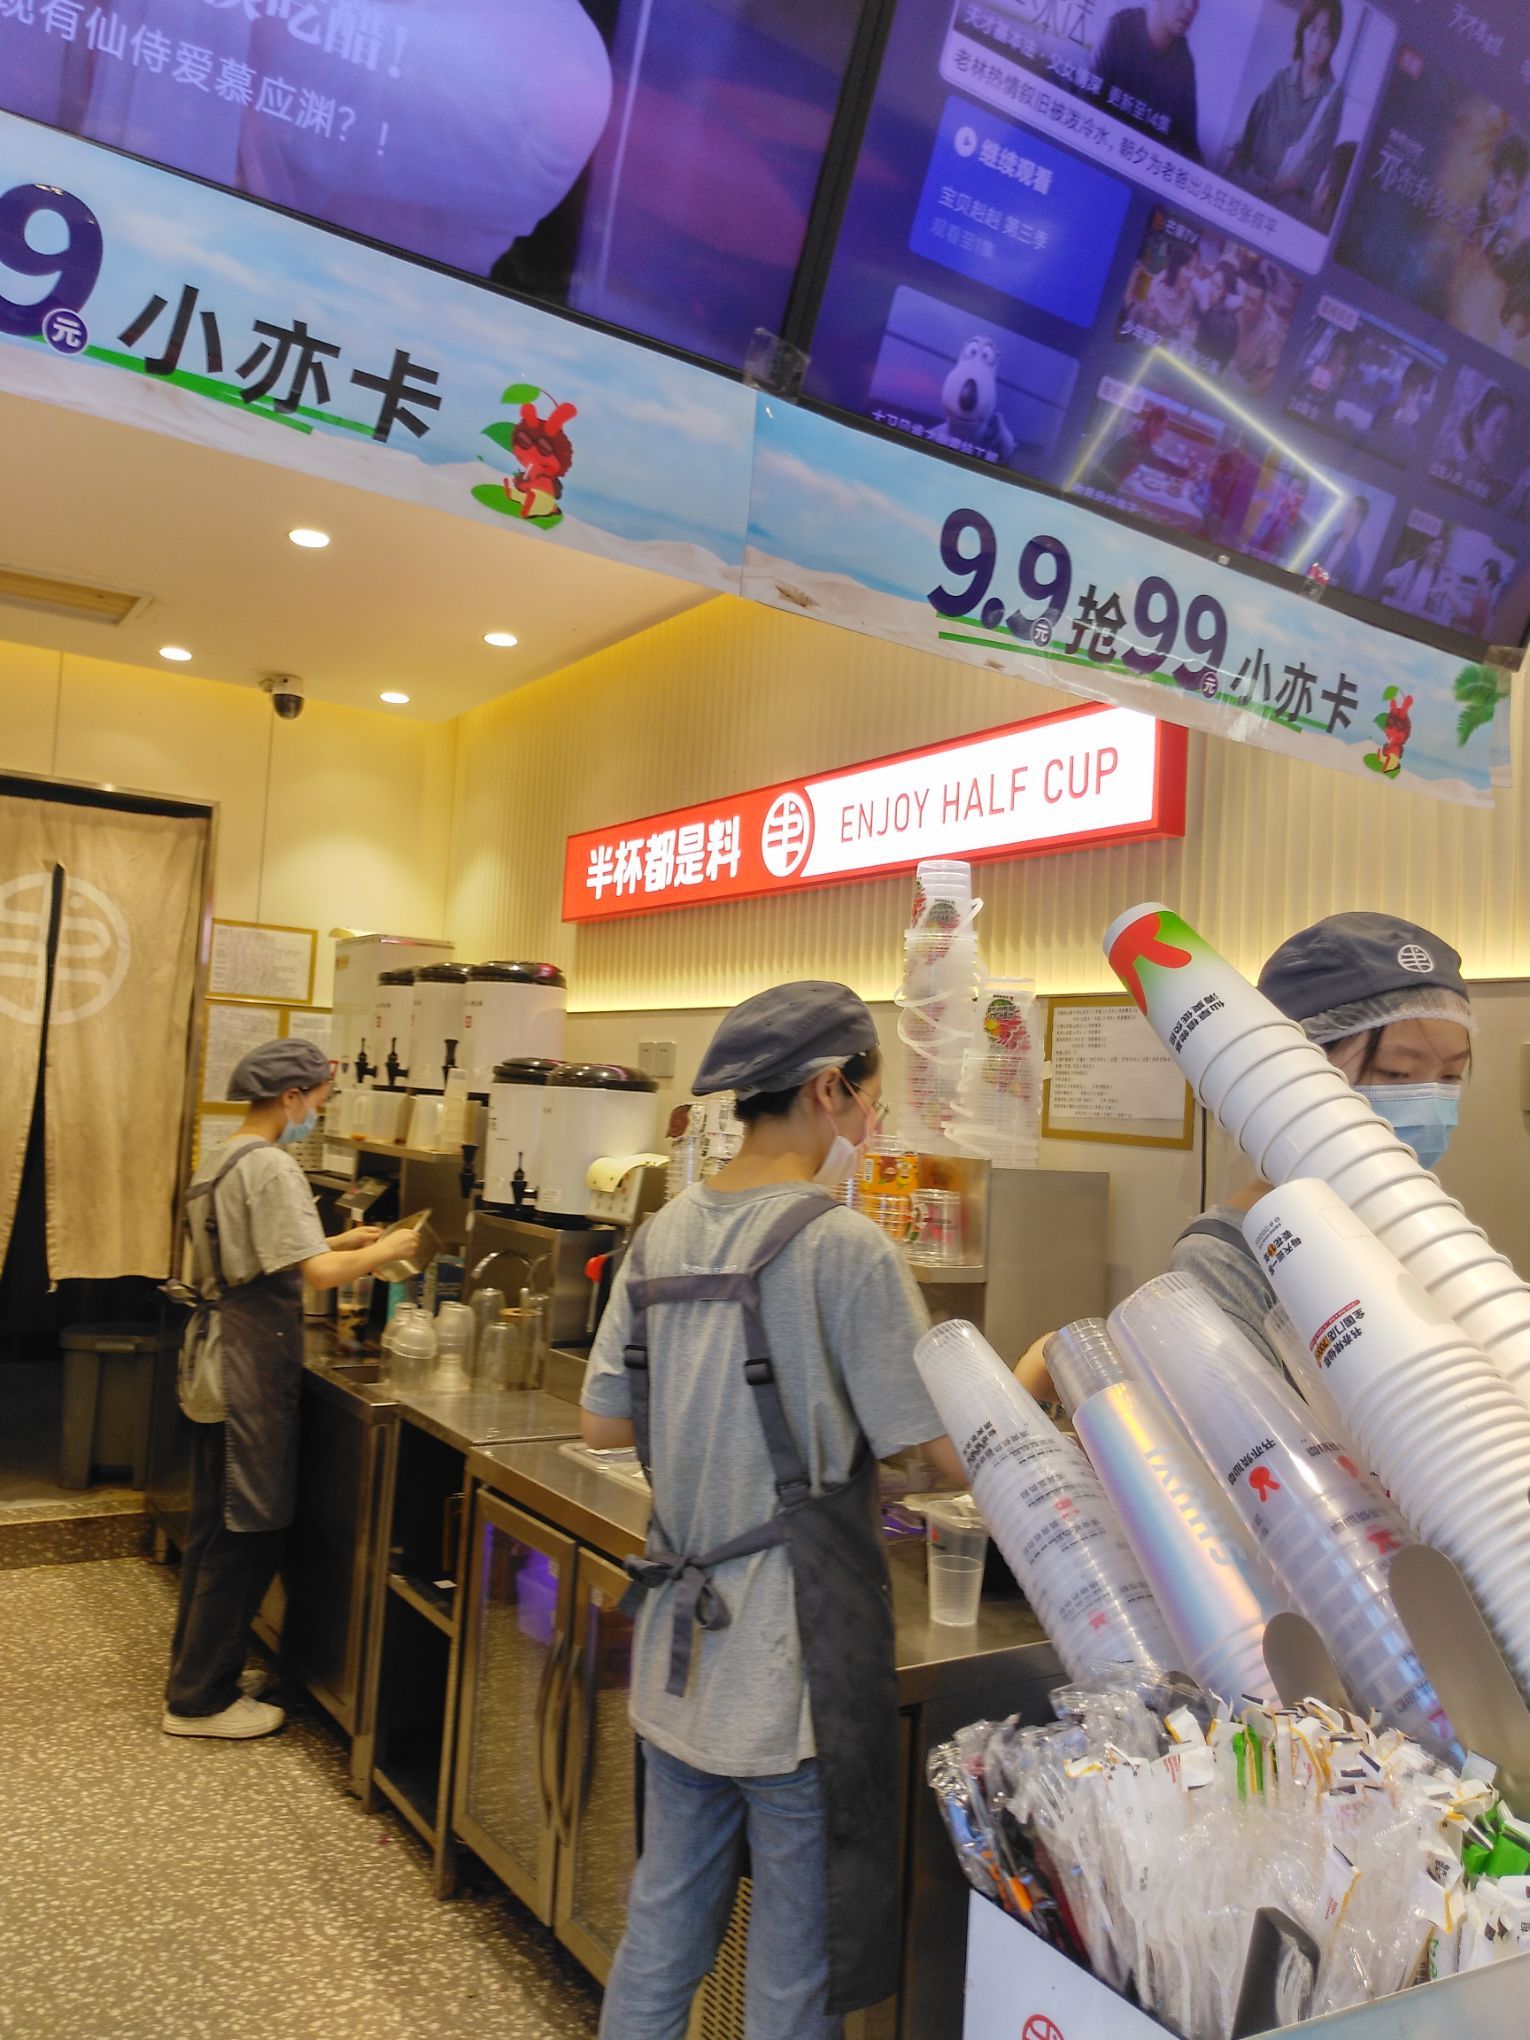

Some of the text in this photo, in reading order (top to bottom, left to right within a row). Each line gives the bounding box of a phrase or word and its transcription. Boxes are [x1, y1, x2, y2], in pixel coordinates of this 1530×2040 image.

[118, 284, 442, 443] 小亦卡
[927, 508, 1072, 642] 9.9
[1063, 583, 1126, 666] 抢
[1122, 577, 1228, 692] 99
[1229, 648, 1359, 736] 小亦卡
[585, 815, 742, 901] 半杯都是料
[841, 746, 1119, 843] ENJOY HALF CUP
